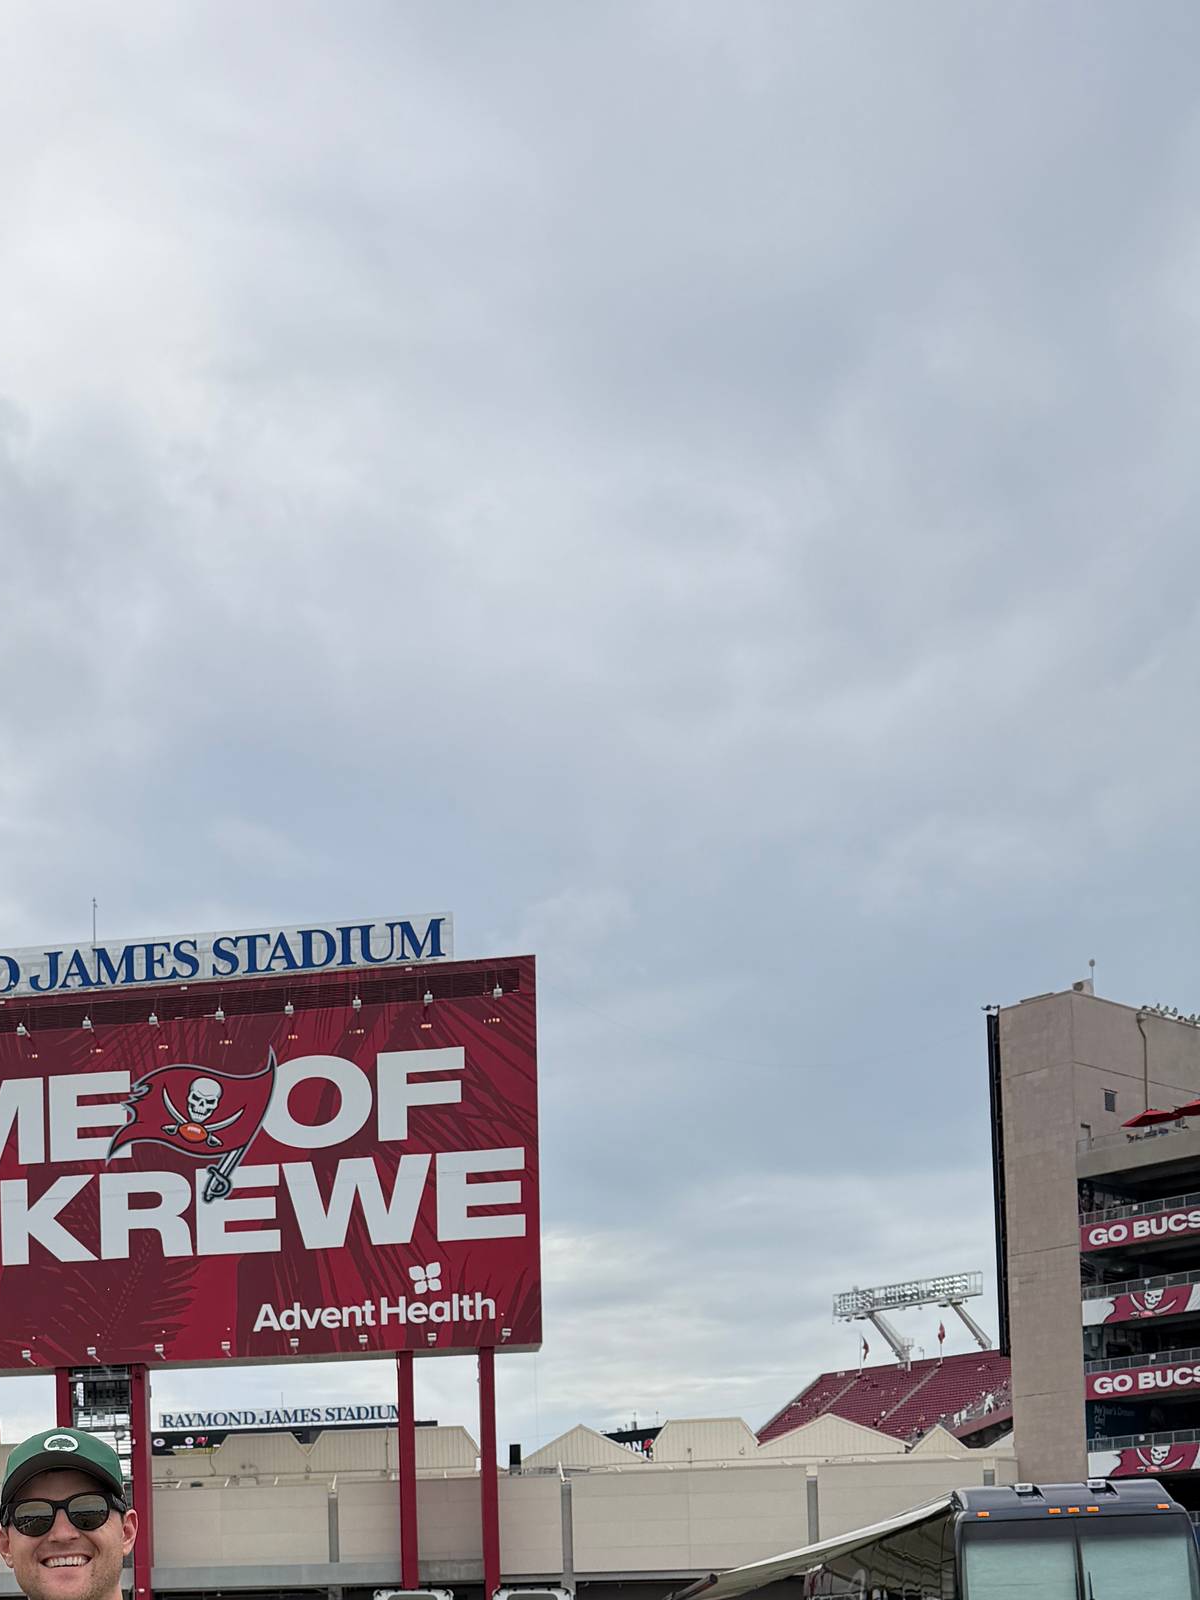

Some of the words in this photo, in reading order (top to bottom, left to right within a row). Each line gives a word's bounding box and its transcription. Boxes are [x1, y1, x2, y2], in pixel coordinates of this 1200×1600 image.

[31, 939, 200, 992] JAMES
[212, 918, 447, 977] STADIUM
[264, 1046, 465, 1150] OF
[0, 1146, 527, 1267] KREWE
[1088, 1223, 1128, 1246] GO
[1133, 1210, 1200, 1240] BUCS
[1093, 1374, 1134, 1394] GO
[161, 1411, 256, 1428] RAYMOND
[259, 1408, 321, 1426] JAMES
